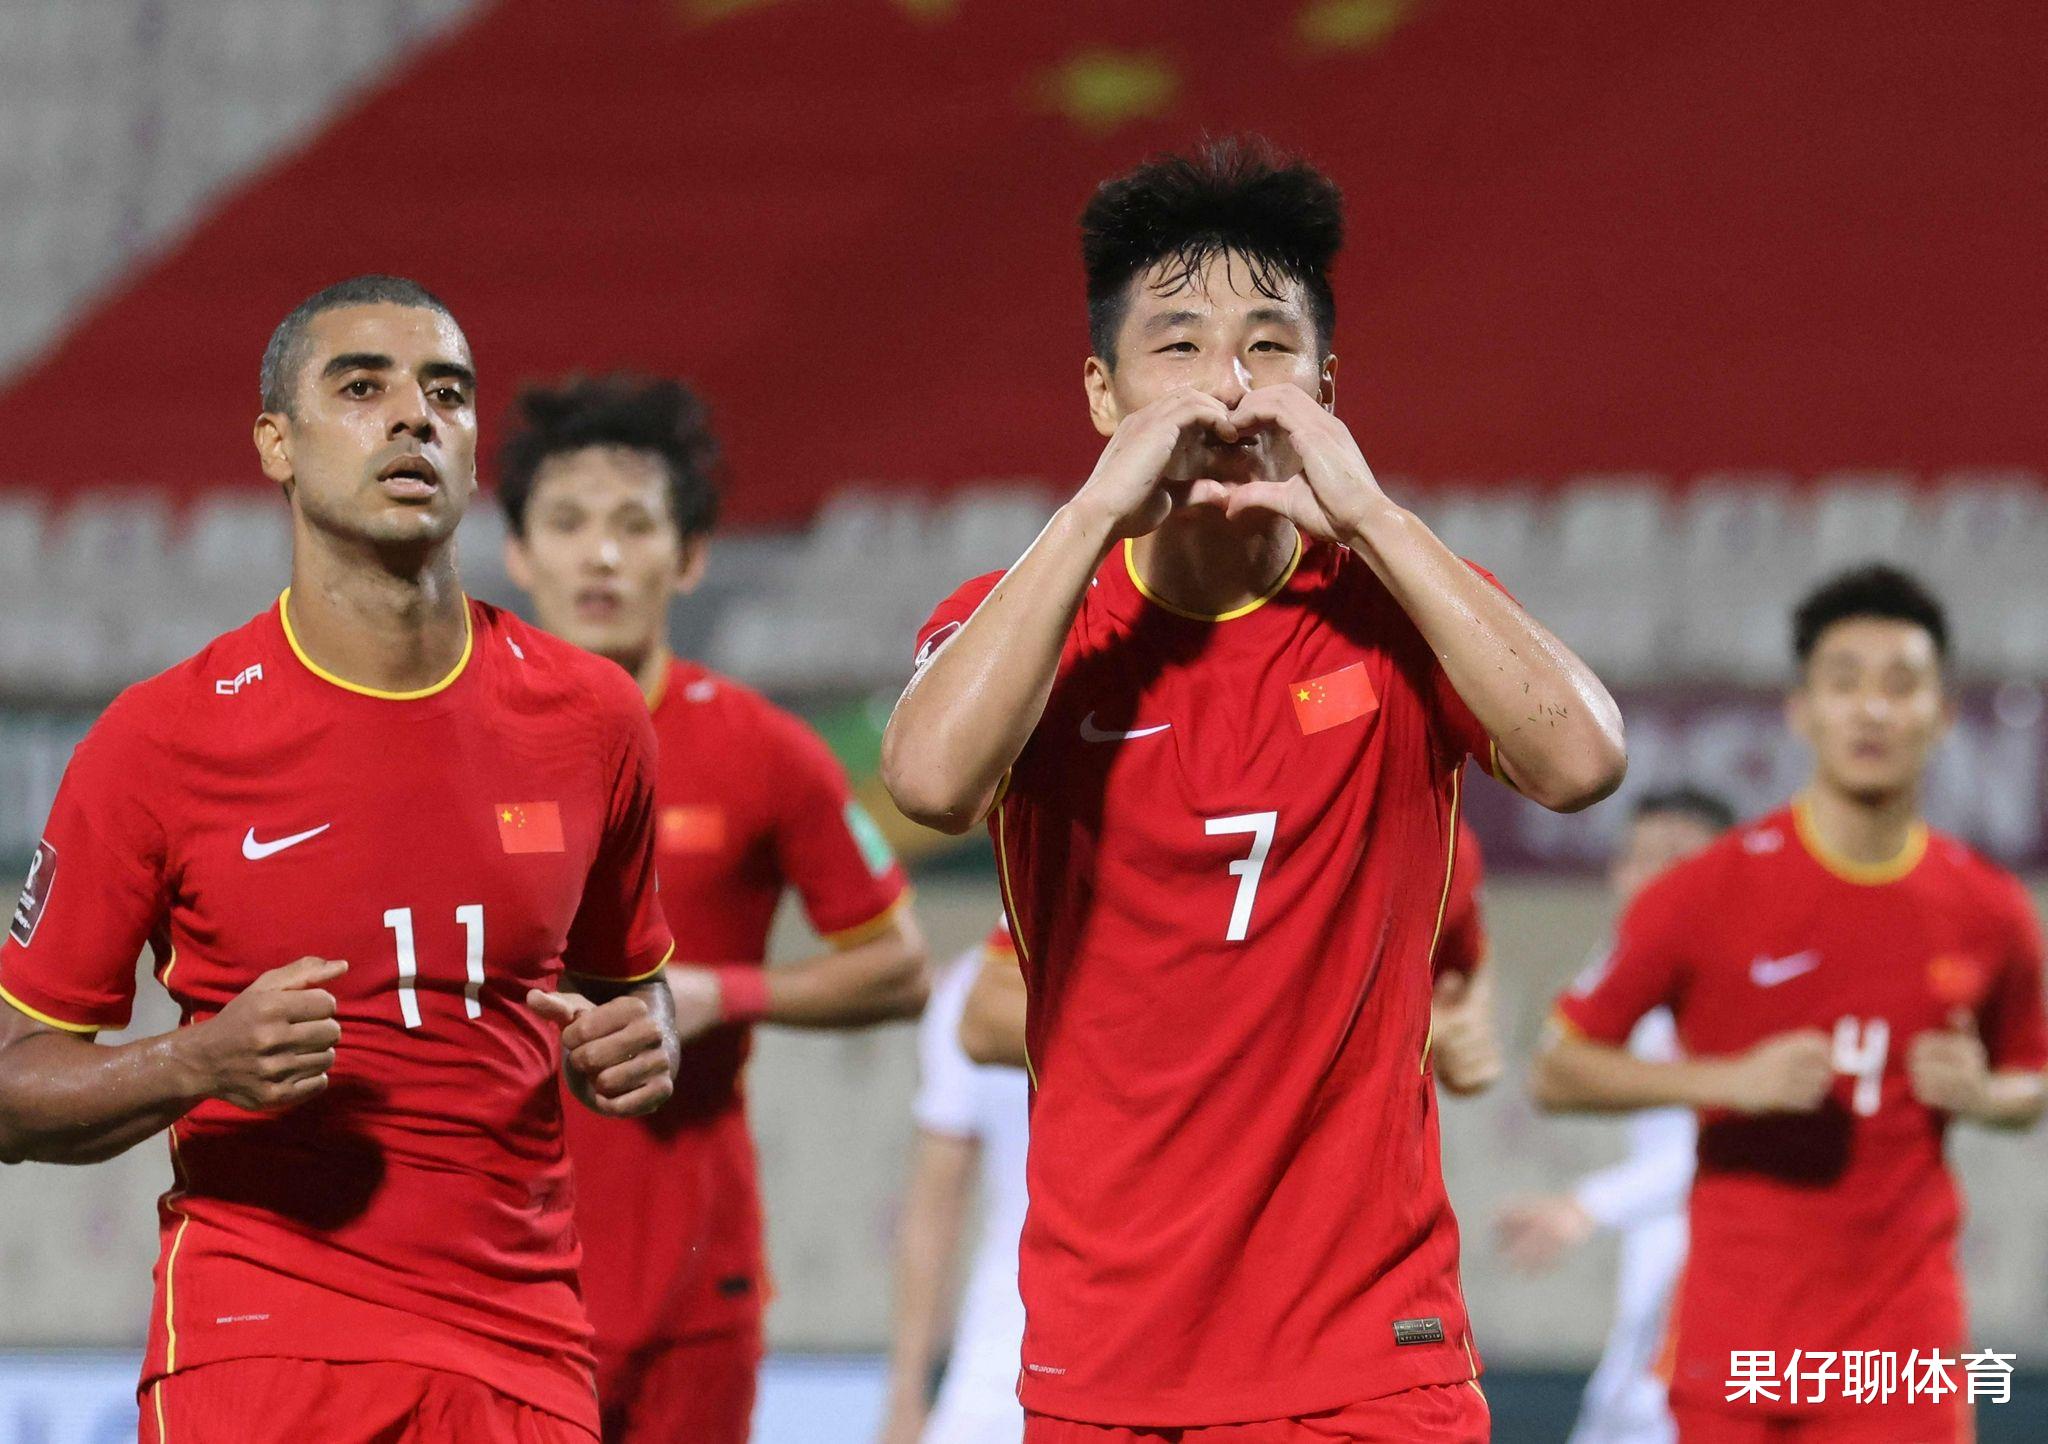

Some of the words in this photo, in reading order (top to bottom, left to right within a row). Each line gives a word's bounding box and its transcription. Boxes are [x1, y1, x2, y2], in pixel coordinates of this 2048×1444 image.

[215, 663, 263, 695] CFA
[1204, 811, 1278, 941] 7
[383, 904, 485, 1029] 11
[1831, 1016, 1890, 1117] 4
